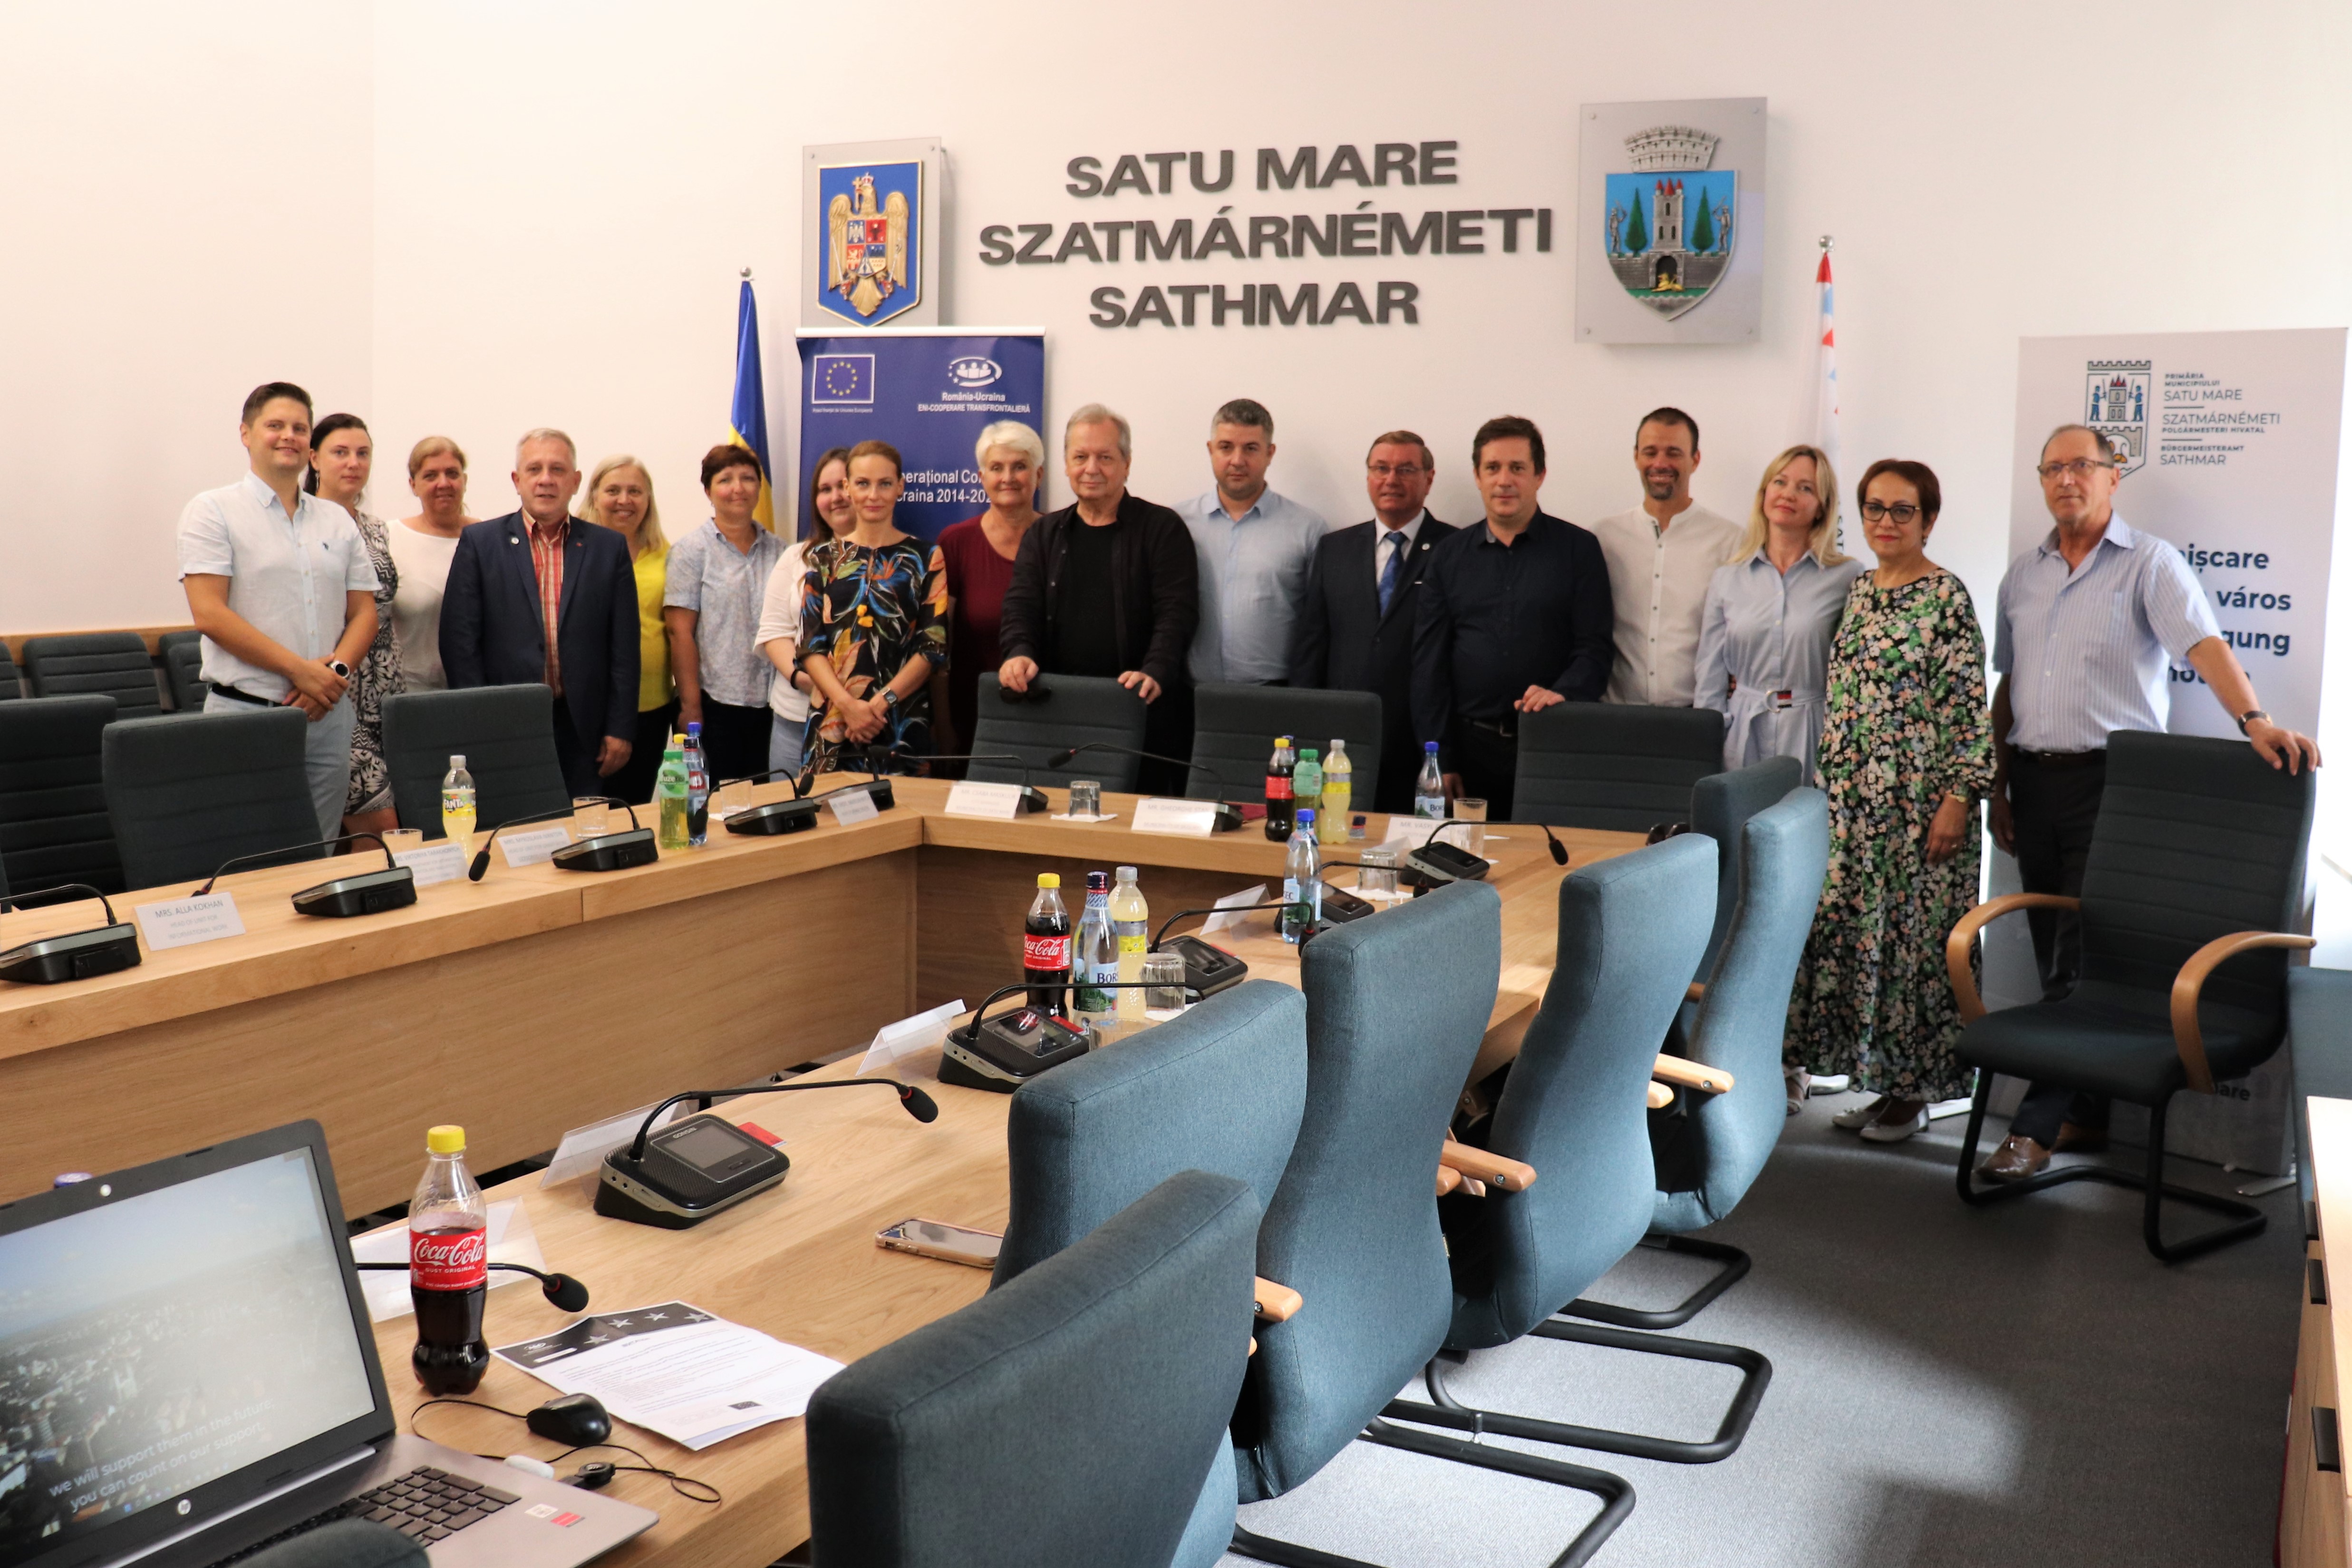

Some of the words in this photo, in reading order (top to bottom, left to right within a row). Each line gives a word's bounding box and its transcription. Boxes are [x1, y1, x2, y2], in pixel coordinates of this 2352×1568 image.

[1065, 149, 1234, 198] SATU
[1257, 141, 1458, 190] MARE
[978, 201, 1551, 266] SZATMÁRNÉMETI
[1089, 281, 1419, 329] SATHMAR
[2164, 390, 2198, 401] SATU
[2202, 389, 2242, 400] MARE
[2162, 411, 2280, 425] SZATMÁRNÉMETI
[2160, 454, 2226, 465] SATHMAR
[2216, 586, 2291, 610] város
[194, 900, 224, 912] KOKHAN
[414, 1231, 486, 1267] Coca-Cola
[445, 1265, 476, 1273] ORIGINAL
[49, 1480, 73, 1497] we
[74, 1466, 99, 1487] will
[101, 1446, 156, 1477] support
[157, 1430, 192, 1454] them
[195, 1424, 209, 1438] in
[210, 1415, 232, 1432] the
[69, 1489, 97, 1514] you
[100, 1478, 126, 1497] can
[127, 1462, 168, 1485] count
[170, 1453, 188, 1468] on
[190, 1444, 212, 1460] our
